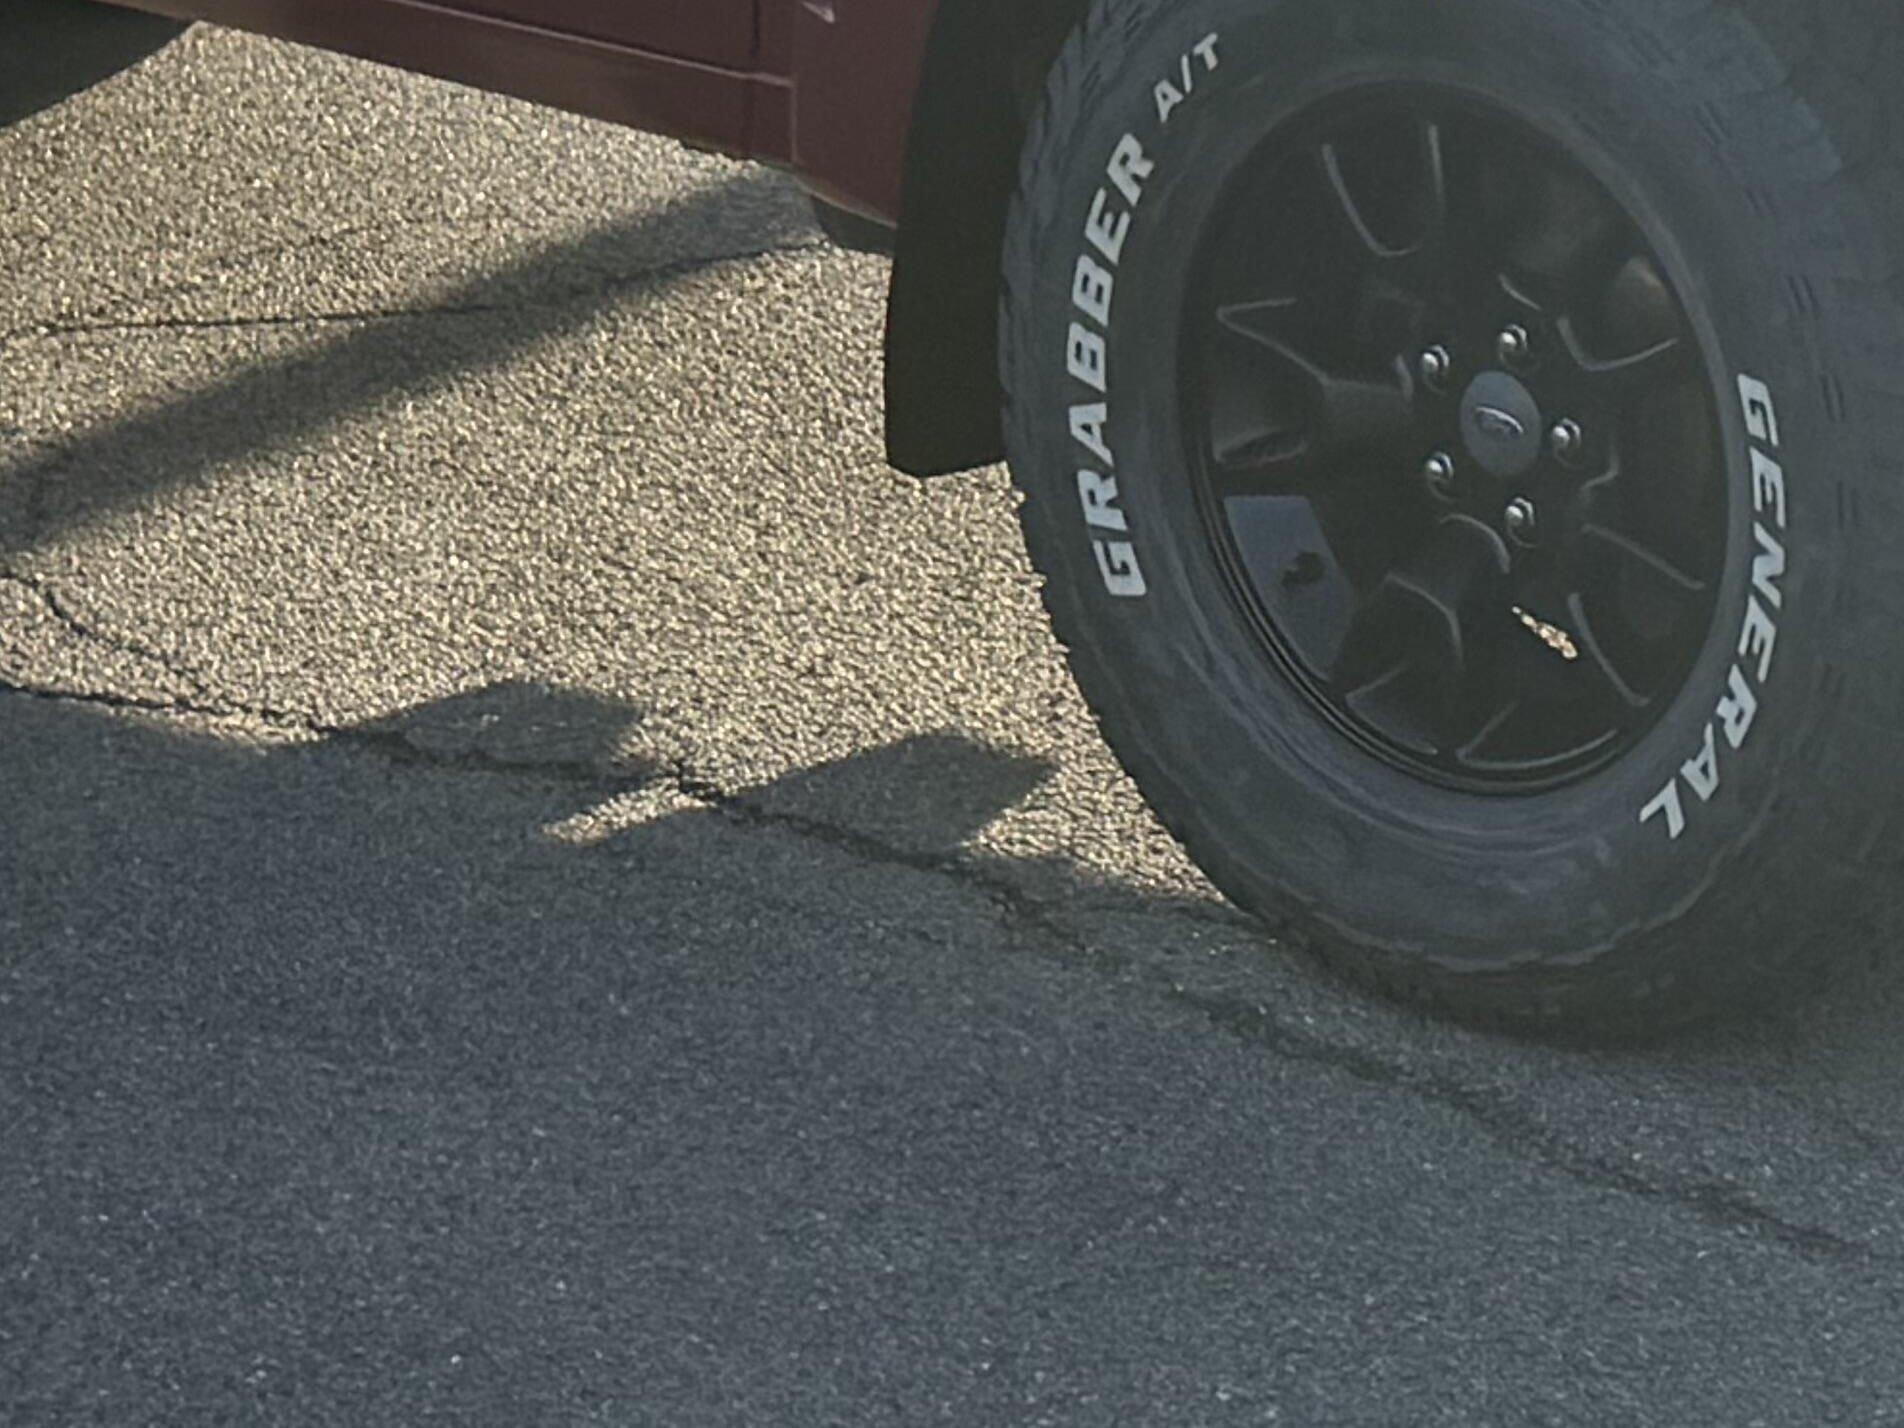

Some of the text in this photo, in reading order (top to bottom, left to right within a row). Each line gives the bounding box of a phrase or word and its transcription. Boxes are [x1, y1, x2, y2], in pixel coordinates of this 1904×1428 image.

[1066, 31, 1220, 598] GRABBER A/T
[1638, 373, 1788, 841] GENERAL
